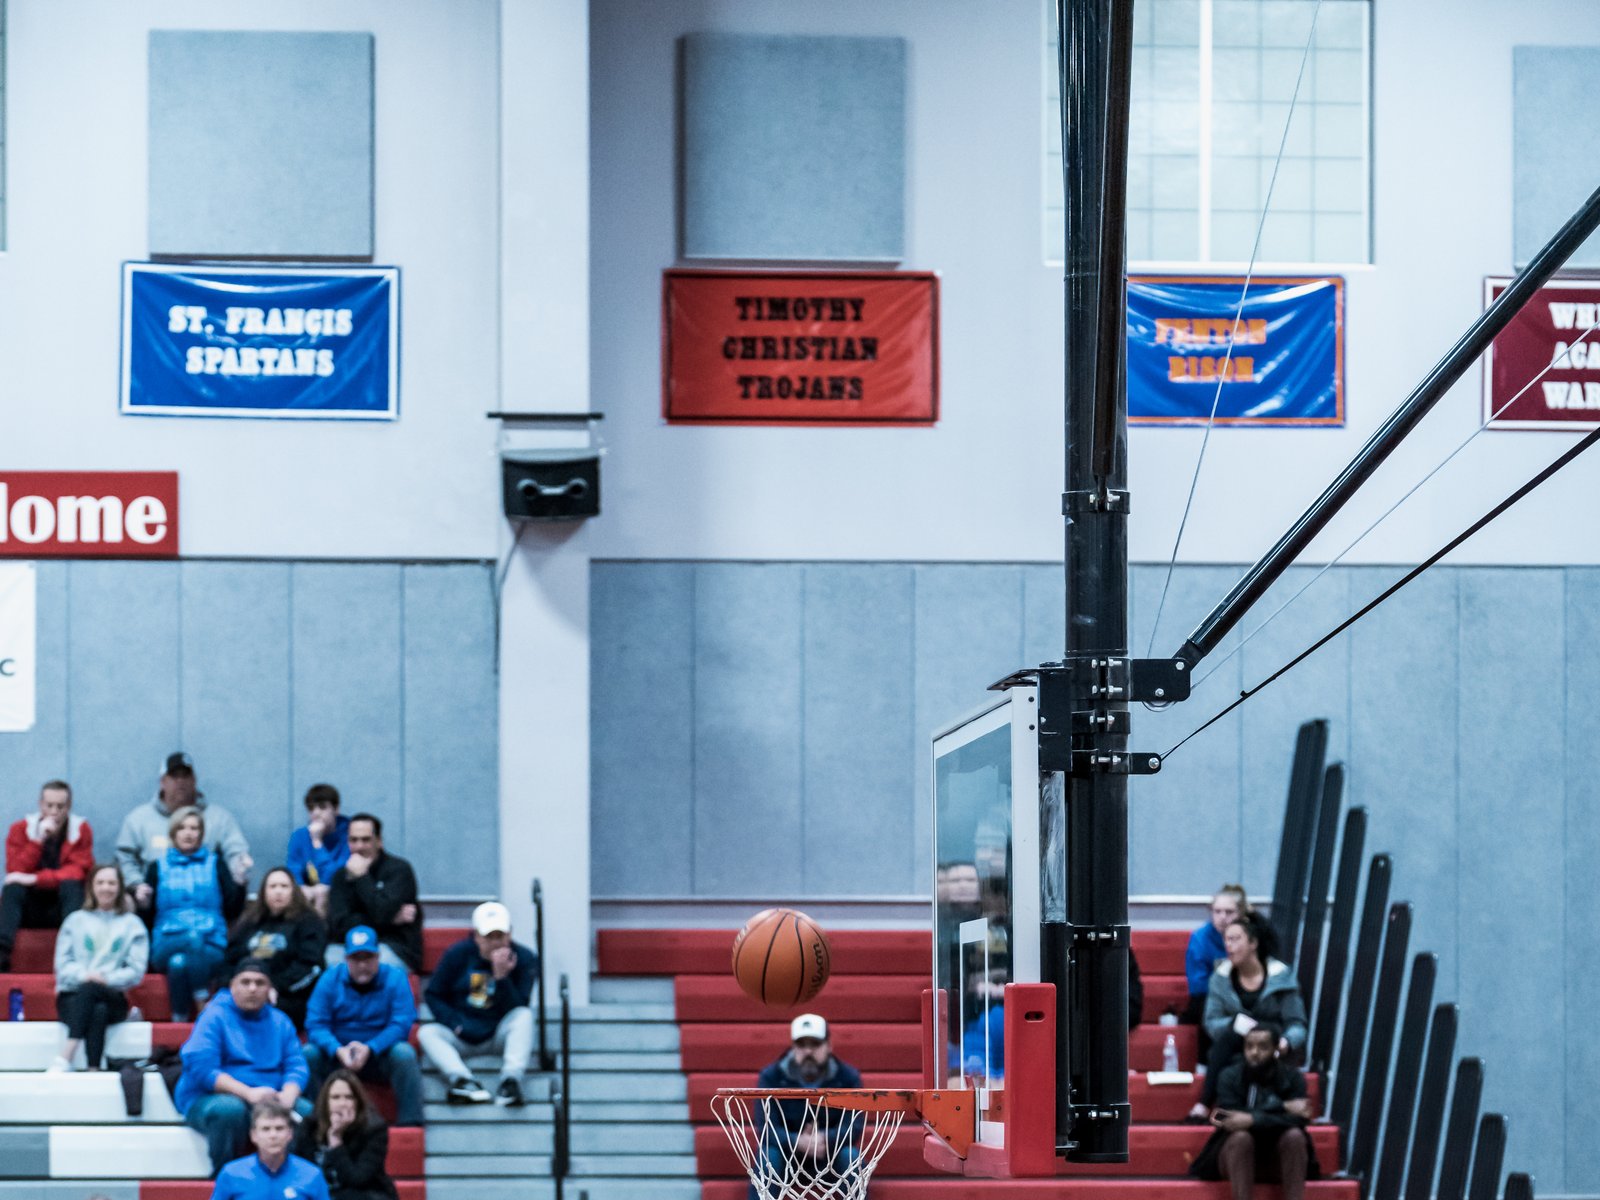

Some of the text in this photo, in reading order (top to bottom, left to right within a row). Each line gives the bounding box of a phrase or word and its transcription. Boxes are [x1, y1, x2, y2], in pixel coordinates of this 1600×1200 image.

[168, 305, 352, 336] ST. FRANCIS
[735, 297, 865, 321] TIMOTHY
[1548, 302, 1600, 330] WH
[185, 346, 334, 377] SPARTANS
[722, 336, 878, 361] CHRISTIAN
[1168, 357, 1254, 383] BISON
[737, 375, 864, 401] TROJANS
